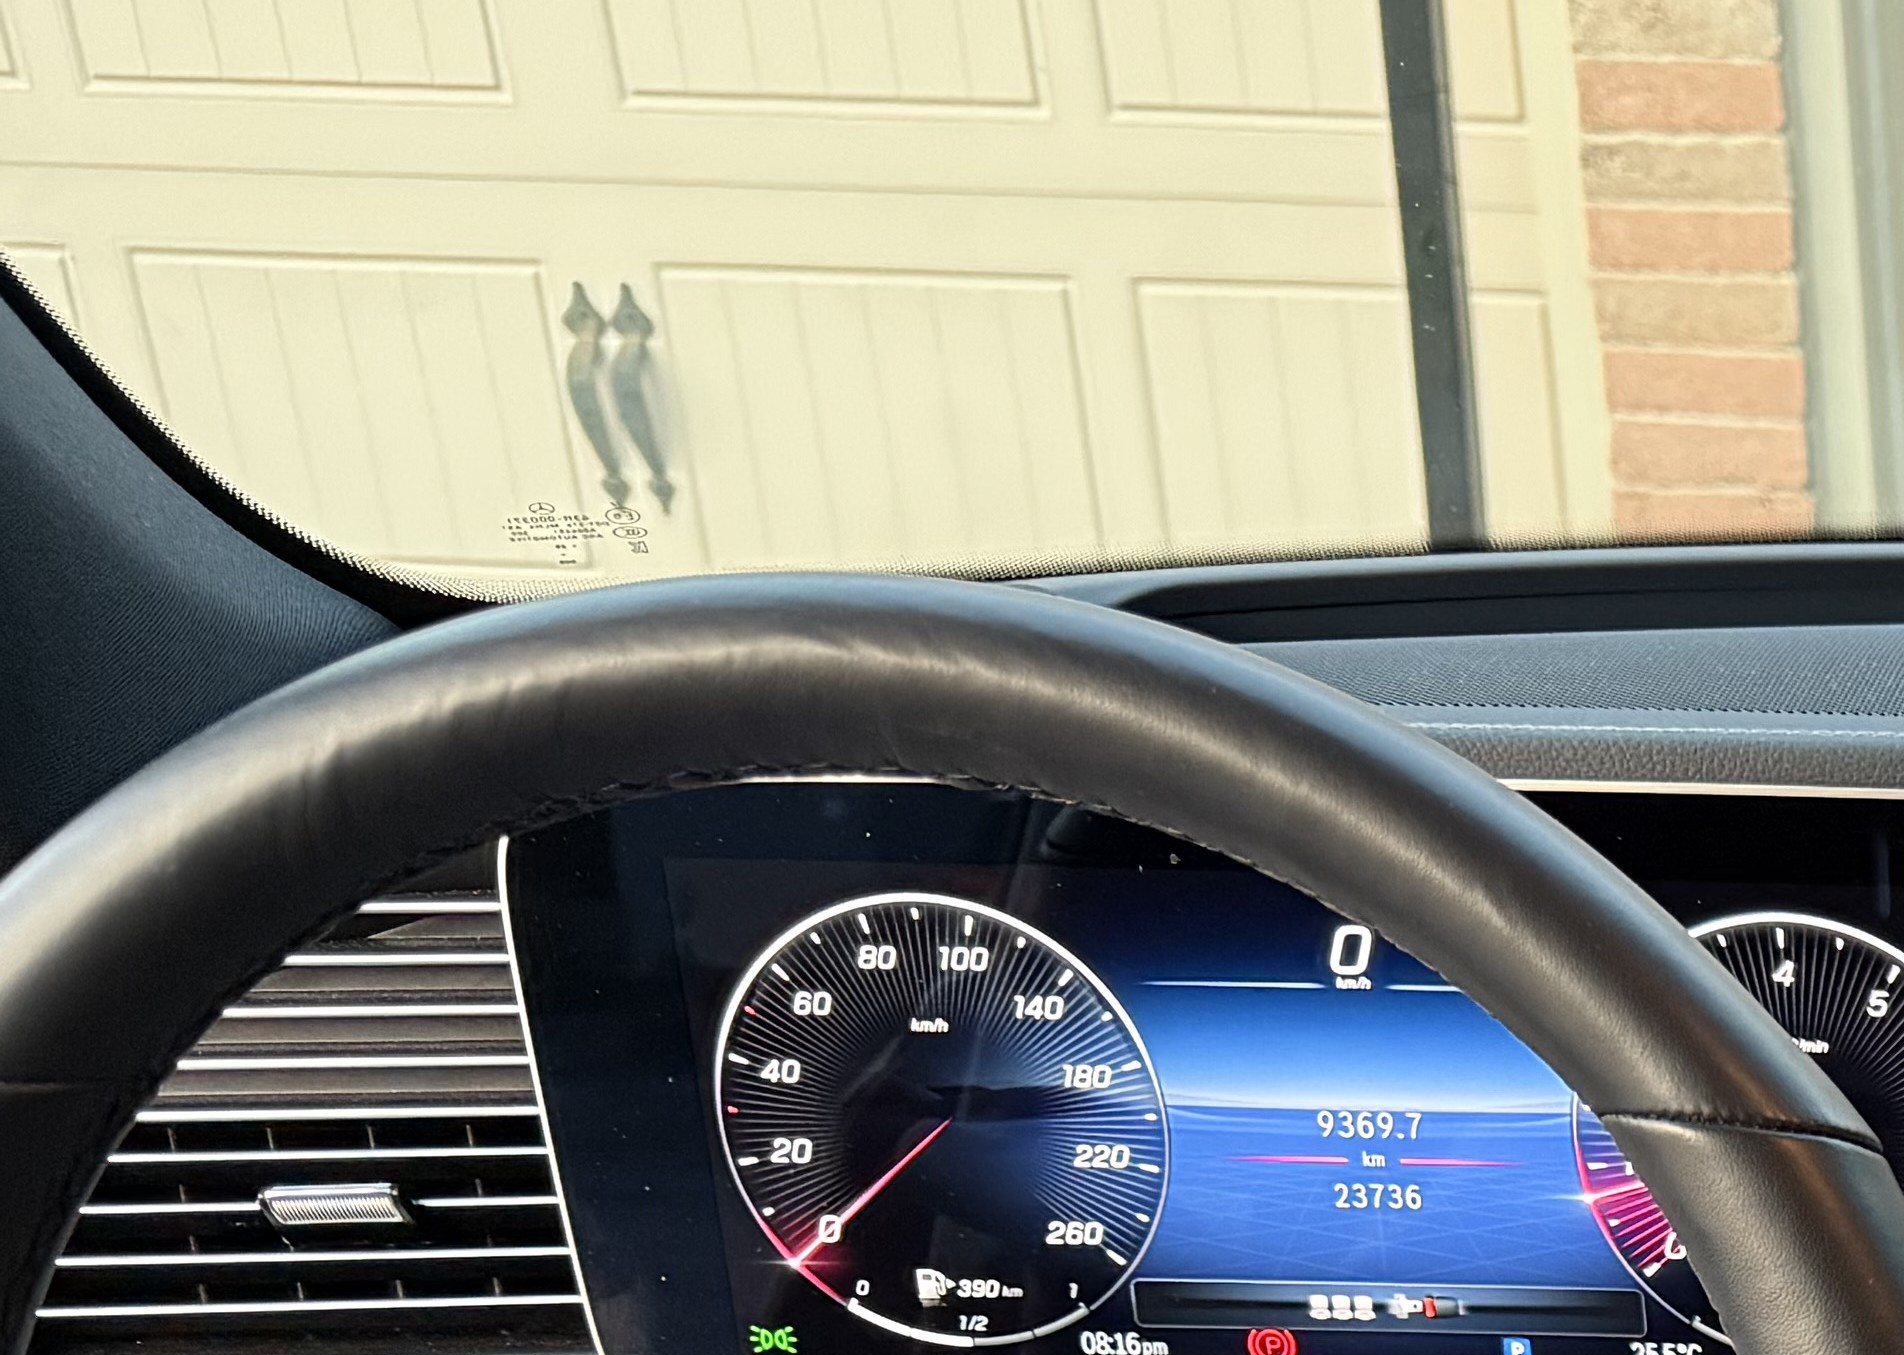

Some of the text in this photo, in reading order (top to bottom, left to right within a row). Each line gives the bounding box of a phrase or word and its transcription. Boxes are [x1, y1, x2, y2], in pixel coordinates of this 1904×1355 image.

[857, 944, 897, 970] 80
[938, 945, 990, 972] 100
[1330, 925, 1372, 975] 0
[1335, 976, 1372, 990] km/h
[1772, 961, 1794, 987] 4
[792, 990, 833, 1016] 60
[1014, 996, 1065, 1020] 140
[1866, 989, 1890, 1018] 5
[910, 1017, 950, 1033] km/h
[759, 1056, 801, 1084] 40
[1063, 1065, 1112, 1089] 180
[1316, 1111, 1420, 1142] 9369.7
[770, 1138, 812, 1162] 20
[1074, 1145, 1129, 1168] 220
[1362, 1152, 1385, 1168] km
[1333, 1183, 1422, 1210] 23736
[819, 1215, 842, 1244] 0
[1046, 1222, 1103, 1246] 260
[855, 1279, 870, 1296] 0
[954, 1278, 1024, 1299] 390 km
[1068, 1282, 1079, 1299] 1
[959, 1314, 989, 1332] 1/2
